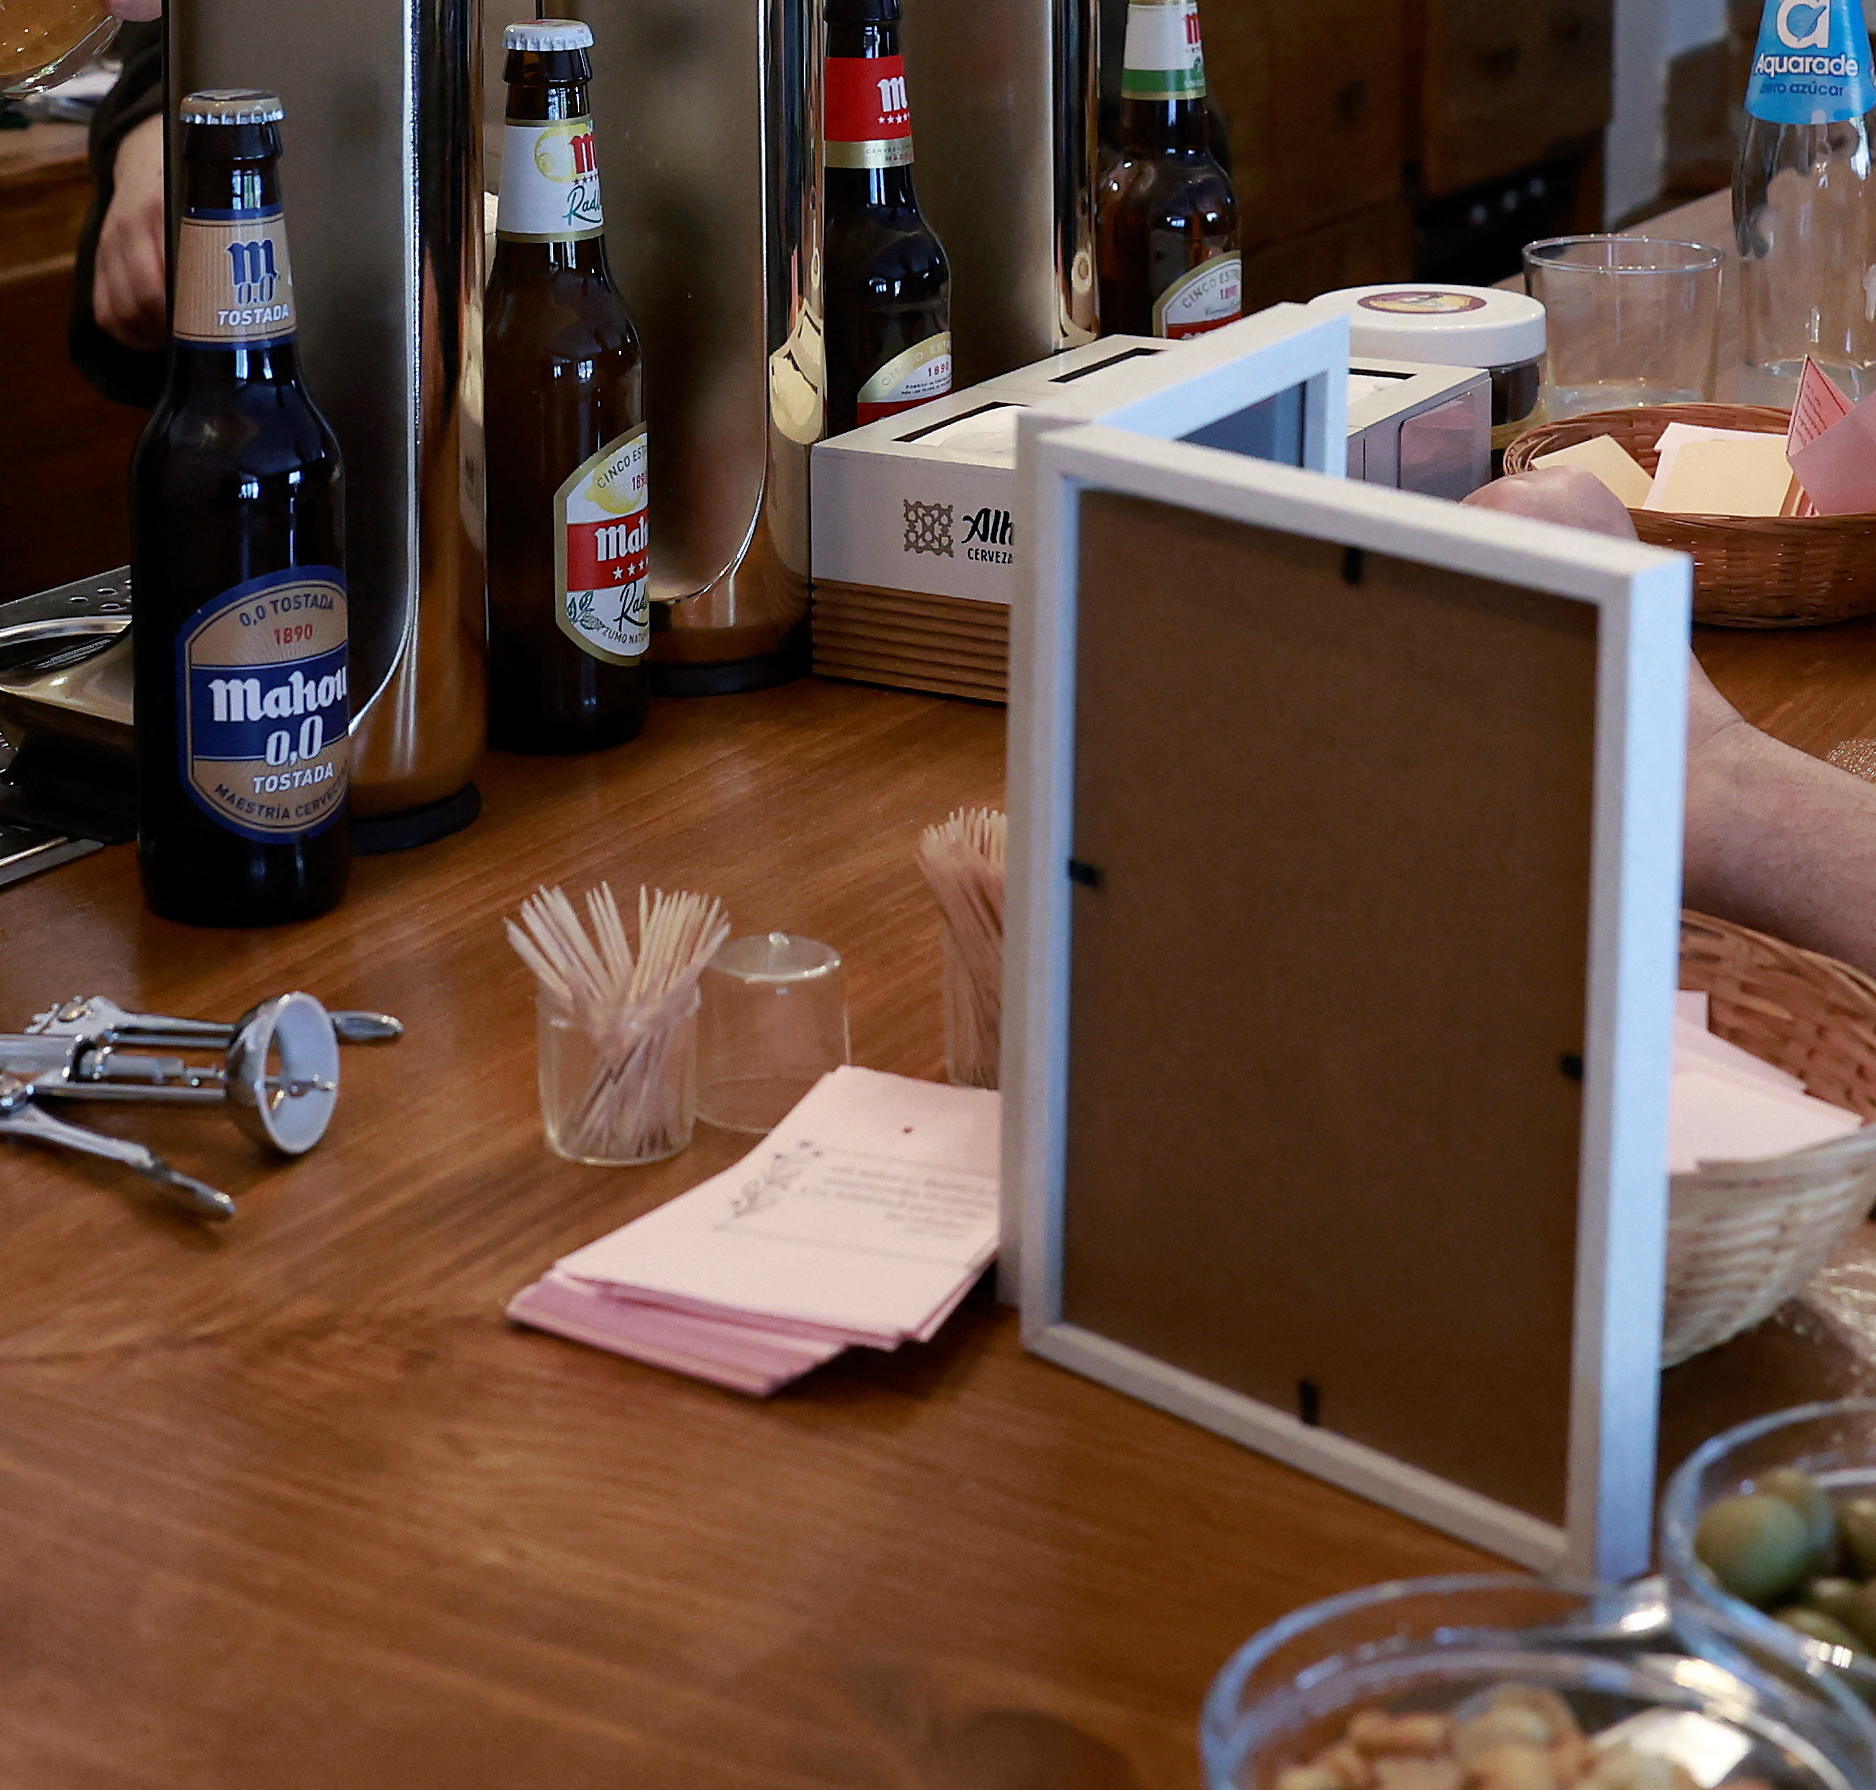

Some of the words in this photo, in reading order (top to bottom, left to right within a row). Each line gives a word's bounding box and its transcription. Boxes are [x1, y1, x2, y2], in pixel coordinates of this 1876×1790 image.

[1755, 52, 1859, 78] Aquarade
[218, 304, 289, 327] TOSTADA
[597, 455, 630, 489] CINCO
[271, 593, 334, 615] TOSTADA
[273, 623, 314, 646] 1890
[265, 713, 324, 767] 0,0
[252, 761, 335, 794] TOSTADA
[214, 783, 291, 820] MAESTRÍA
